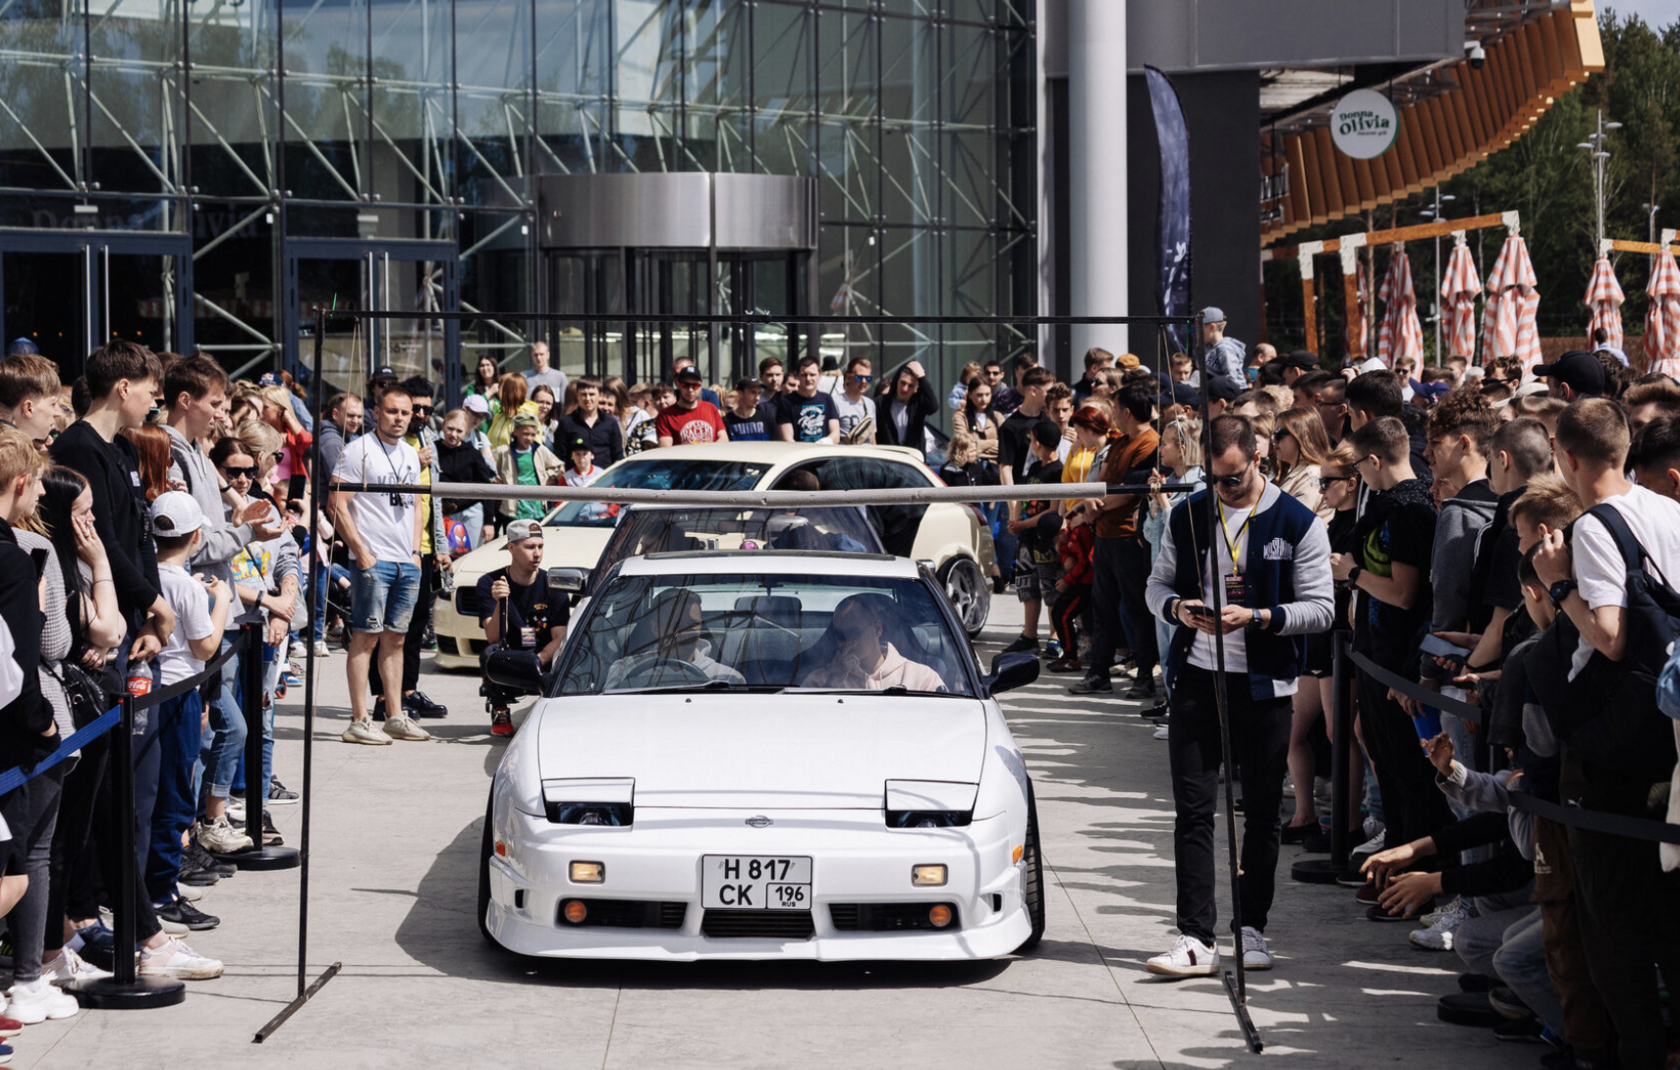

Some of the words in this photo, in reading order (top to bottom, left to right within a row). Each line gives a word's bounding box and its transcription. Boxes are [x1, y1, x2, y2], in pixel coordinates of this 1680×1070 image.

[1339, 110, 1373, 121] Donna
[1339, 114, 1390, 135] Olivia
[724, 858, 740, 880] H
[748, 859, 791, 880] 817
[719, 884, 753, 906] CK
[775, 885, 804, 902] 196
